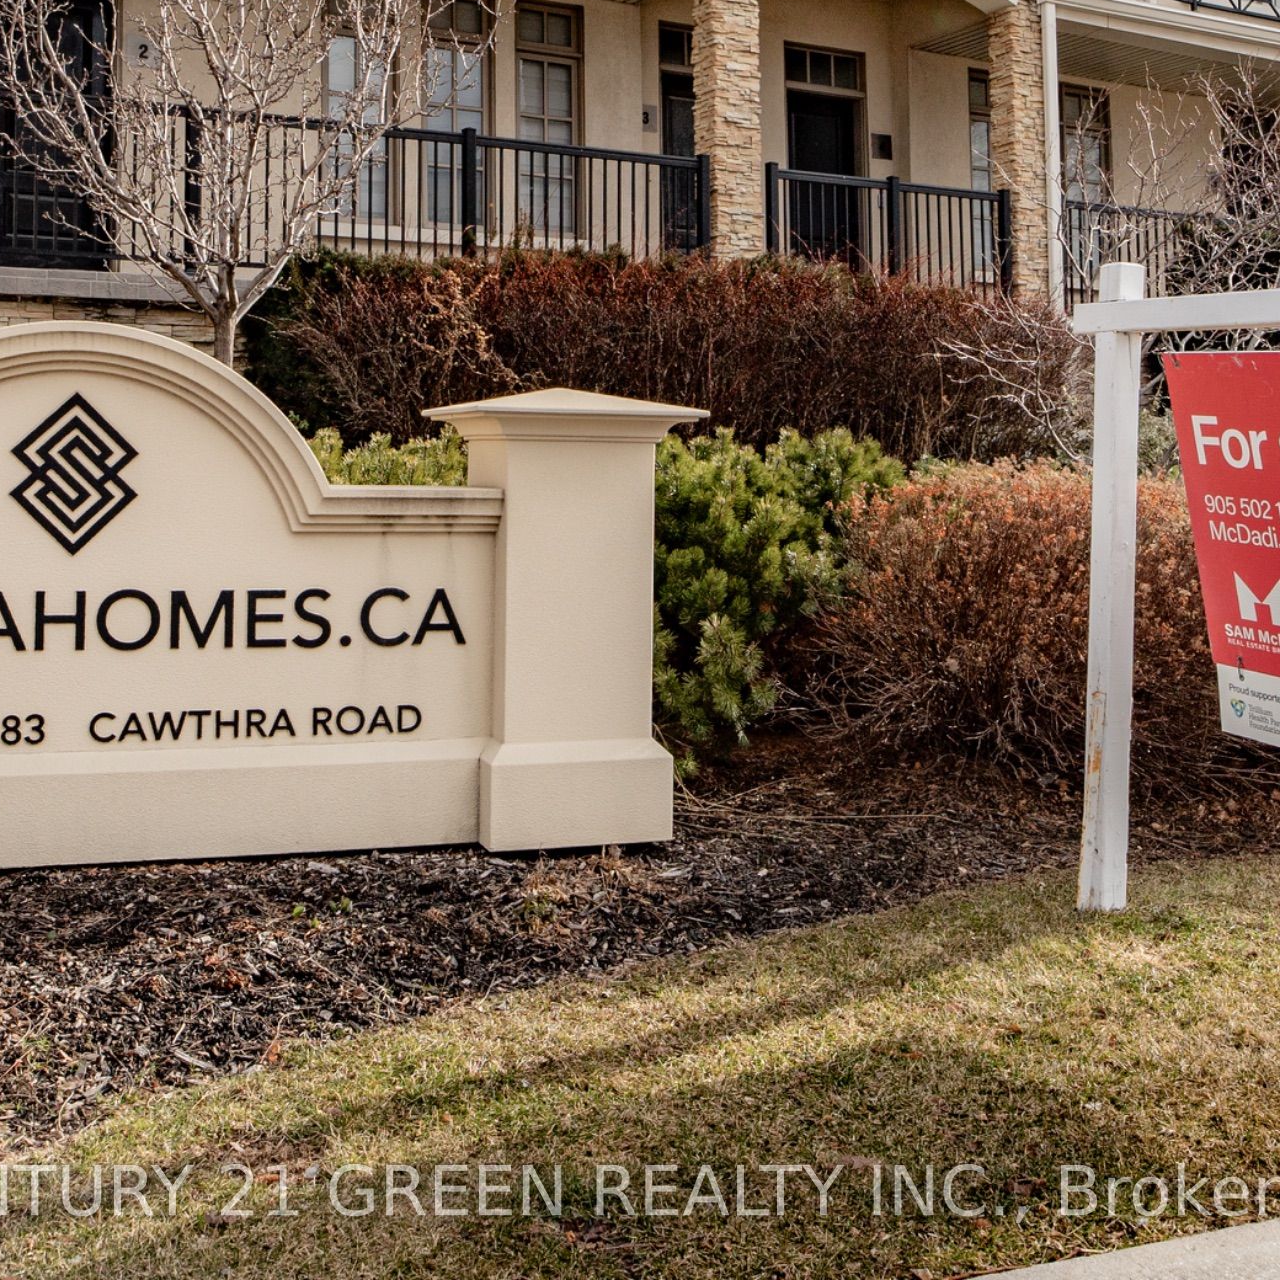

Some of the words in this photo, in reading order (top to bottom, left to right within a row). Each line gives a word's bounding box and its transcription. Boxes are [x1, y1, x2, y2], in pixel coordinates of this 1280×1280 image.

[138, 43, 149, 60] 2
[641, 111, 650, 125] 3
[1190, 414, 1268, 470] For
[1204, 494, 1237, 516] 905
[1240, 497, 1274, 520] 502
[1224, 623, 1255, 641] SAM
[1227, 637, 1245, 647] REAL
[1246, 640, 1271, 653] ESTATE
[1228, 682, 1250, 696] Proud
[89, 708, 296, 744] CAWTHRA
[312, 704, 422, 736] ROAD
